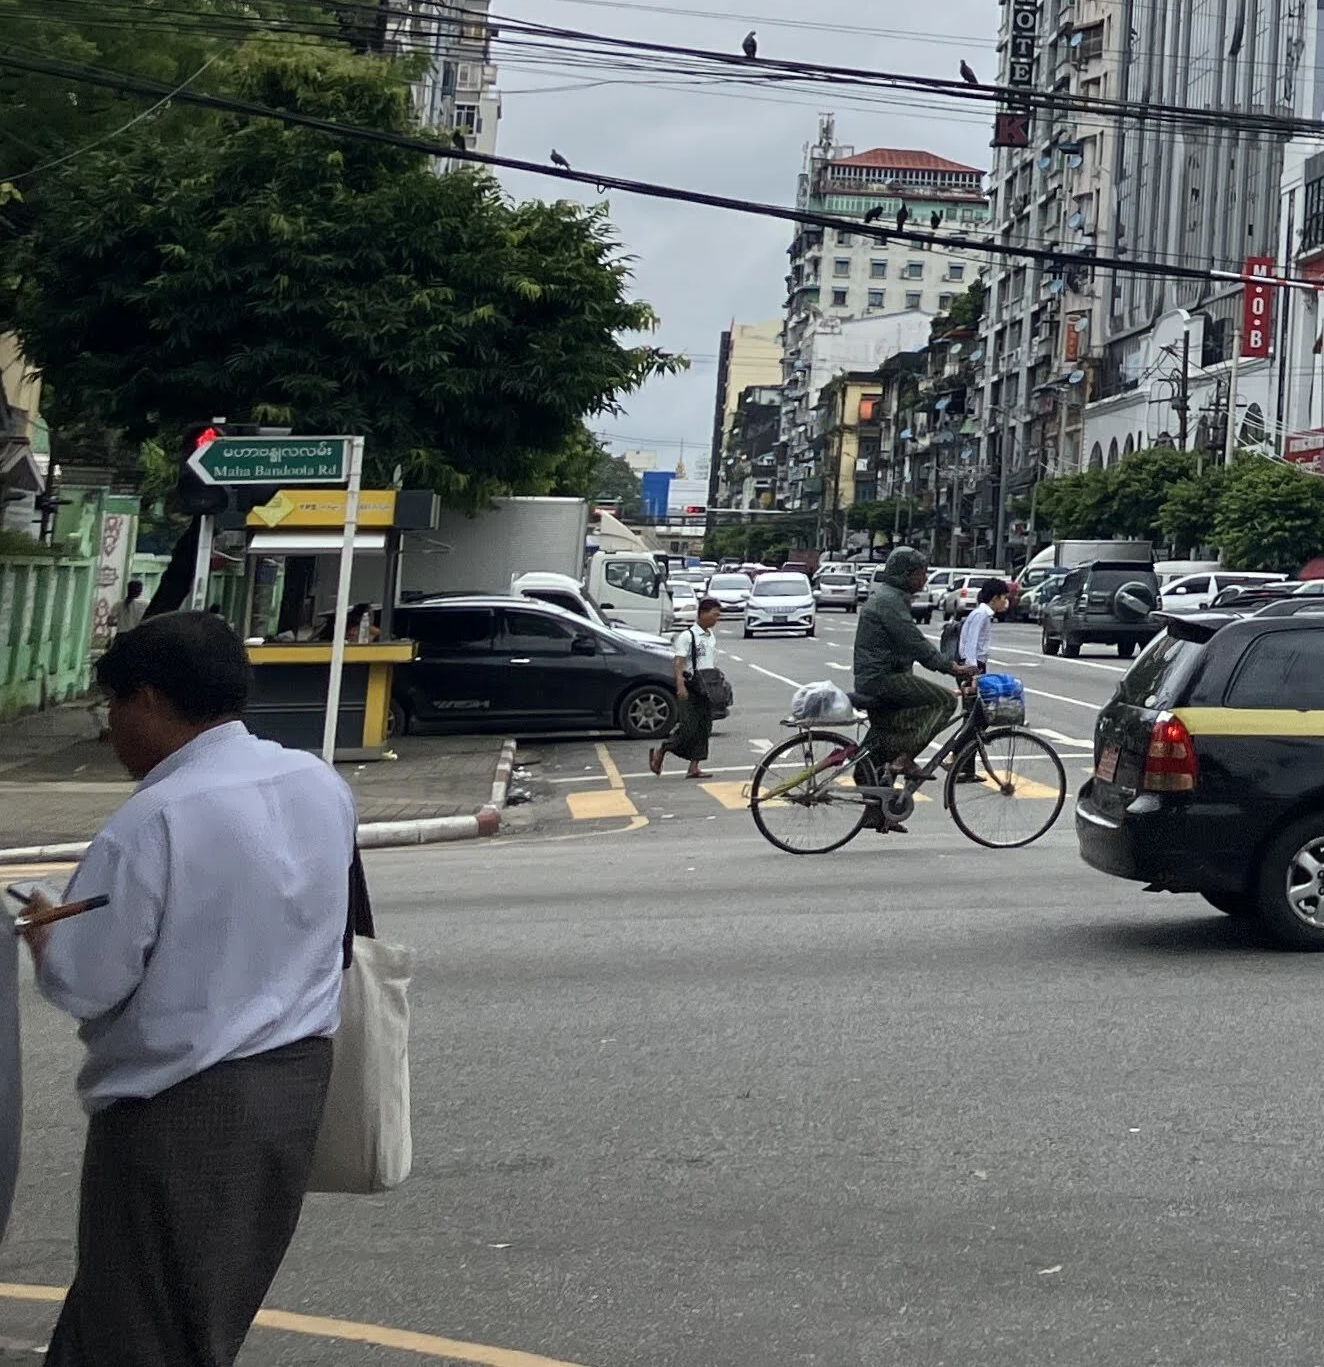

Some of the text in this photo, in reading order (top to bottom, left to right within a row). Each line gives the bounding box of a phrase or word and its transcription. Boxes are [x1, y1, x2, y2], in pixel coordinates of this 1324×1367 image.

[1001, 116, 1028, 144] K
[213, 463, 338, 477] Maha Bandoola Rd
